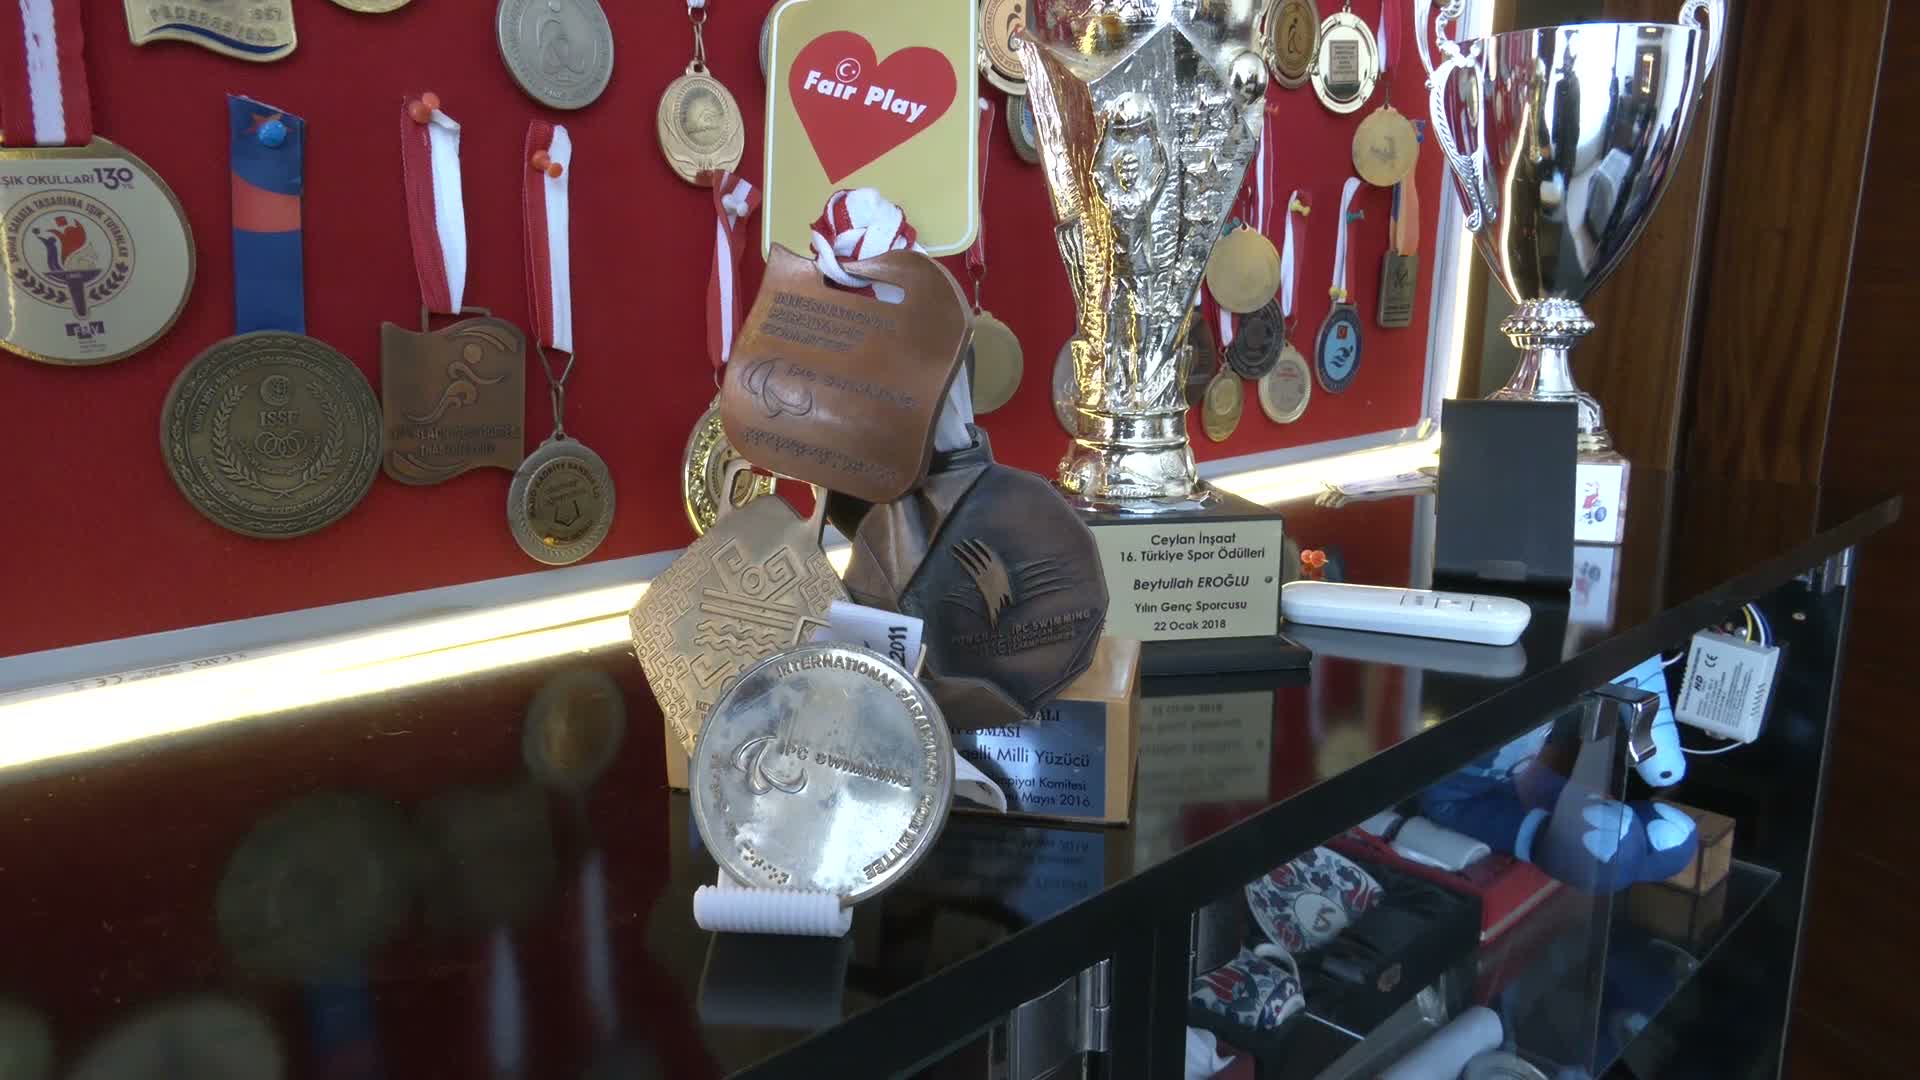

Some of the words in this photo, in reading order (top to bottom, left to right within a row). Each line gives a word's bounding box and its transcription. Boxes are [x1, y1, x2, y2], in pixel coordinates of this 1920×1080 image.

[803, 70, 857, 100] Fair
[864, 85, 927, 123] Play
[0, 175, 24, 188] ŞIK
[93, 168, 134, 189] 130
[1151, 534, 1196, 548] Ceylan
[1199, 530, 1237, 546] İnşaat
[1120, 551, 1137, 563] 16.
[1141, 550, 1184, 563] Türkiye
[1187, 549, 1214, 563] Spor
[1218, 547, 1265, 560] Ödülleri
[1133, 577, 1194, 592] Beytullah
[1197, 573, 1250, 589] EROĞLU
[1134, 602, 1157, 614] Yılın
[1161, 601, 1192, 614] Genç
[1195, 600, 1248, 613] Sporcusu
[1034, 610, 1090, 631] SWIMMING
[1154, 621, 1167, 631] 22
[1169, 620, 1199, 630] Ocak
[1202, 619, 1226, 629] 2018
[888, 627, 908, 668] 2011
[776, 654, 896, 692] INTERNATIONAL
[996, 746, 1029, 763] Milli
[1035, 751, 1090, 768] Yüzücü
[1039, 775, 1087, 792] Komitesi
[1060, 794, 1091, 808] 2016
